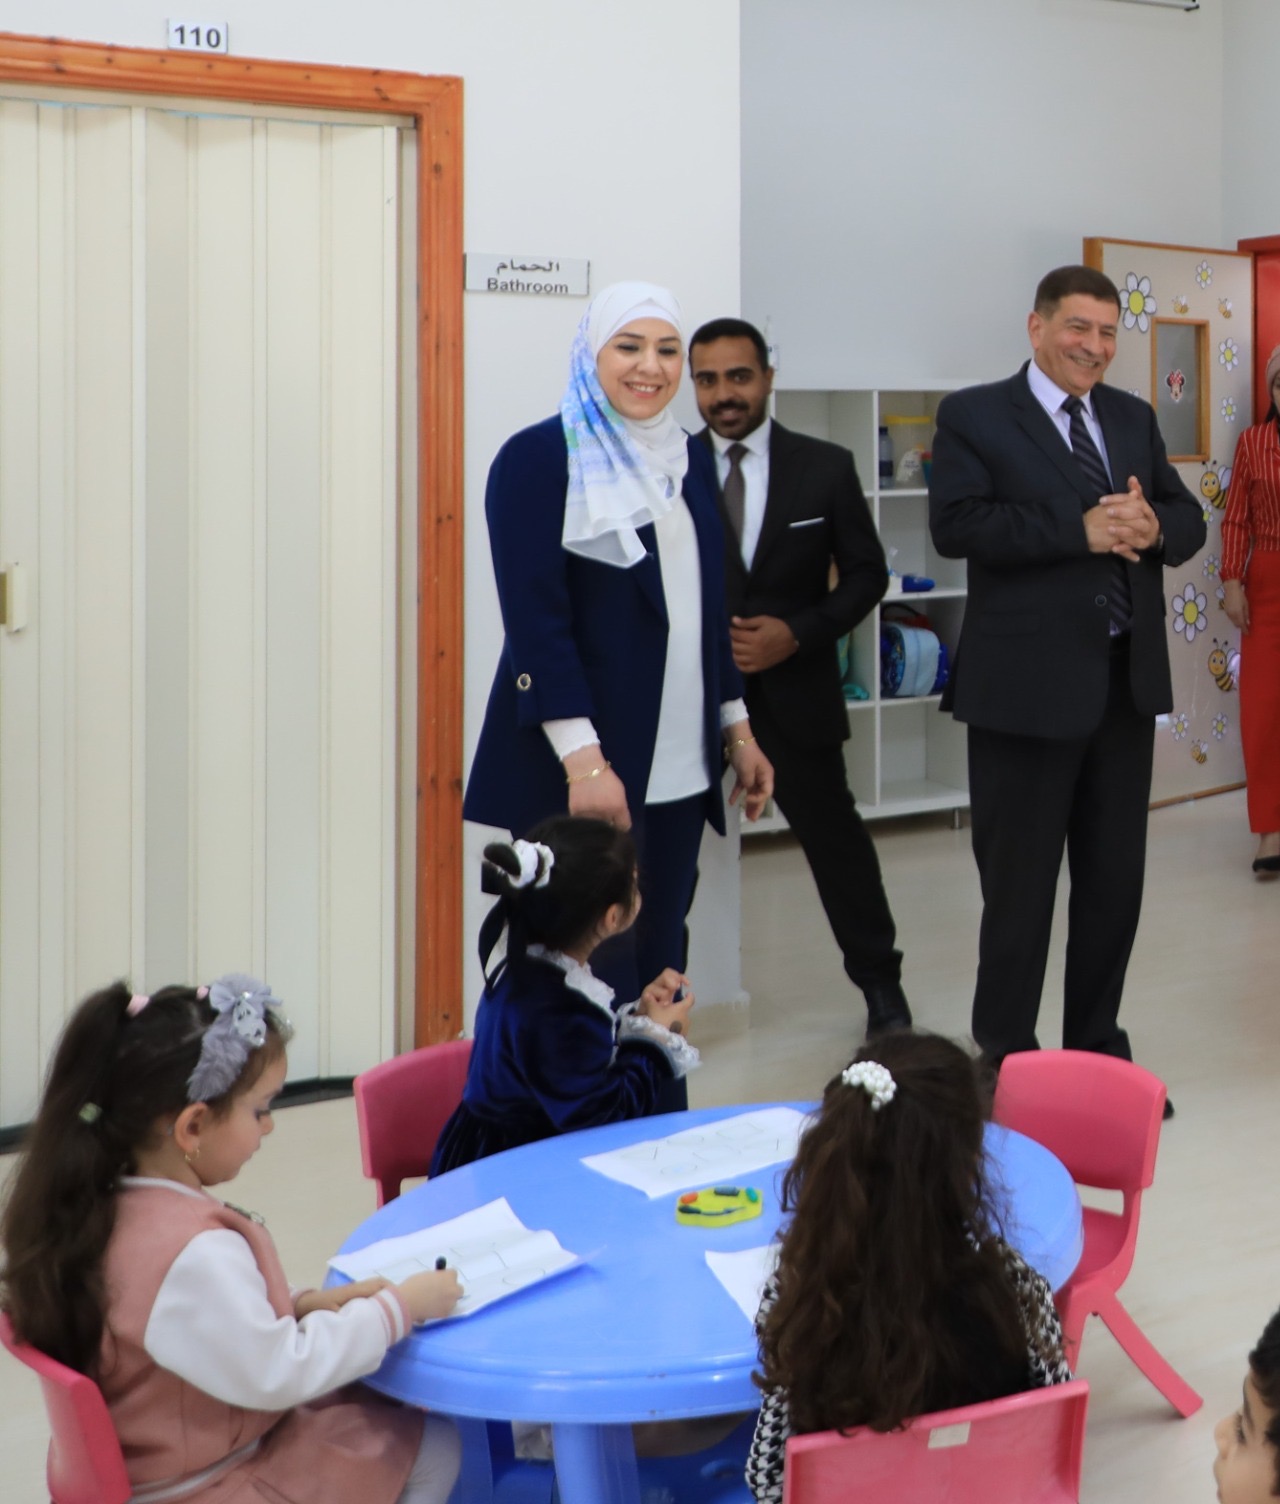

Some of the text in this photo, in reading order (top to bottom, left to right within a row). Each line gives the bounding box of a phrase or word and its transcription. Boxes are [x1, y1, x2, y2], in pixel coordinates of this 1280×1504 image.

[174, 25, 221, 48] 110
[496, 258, 560, 275] الحمام
[487, 277, 569, 293] Bathroom
